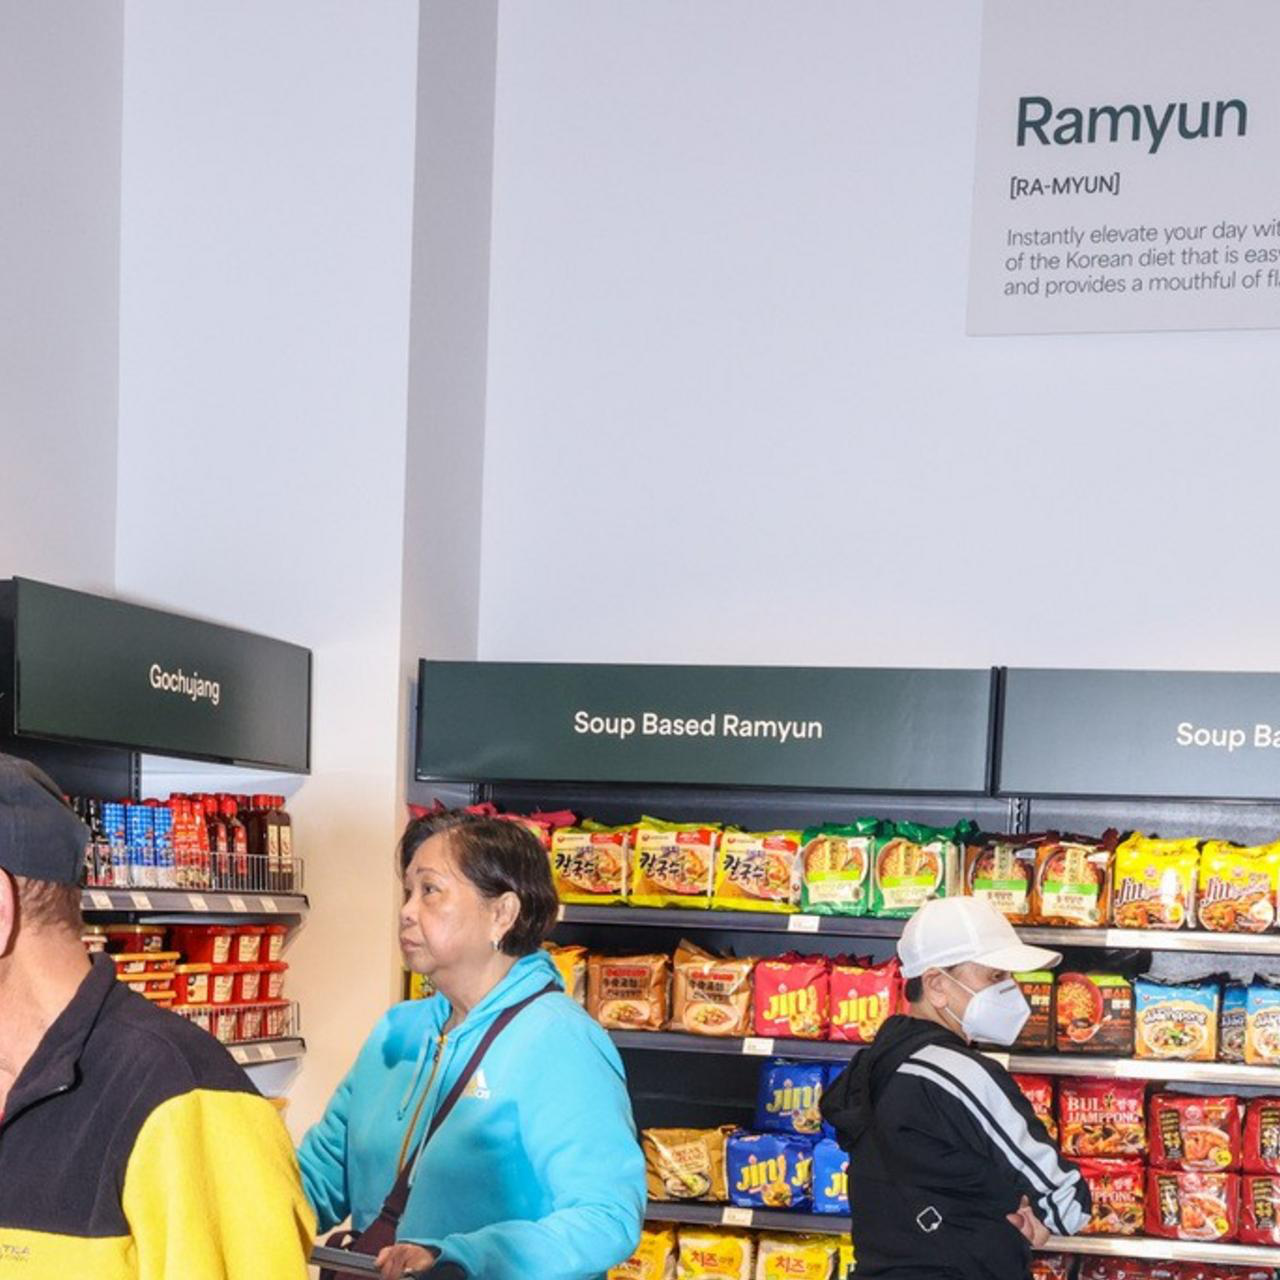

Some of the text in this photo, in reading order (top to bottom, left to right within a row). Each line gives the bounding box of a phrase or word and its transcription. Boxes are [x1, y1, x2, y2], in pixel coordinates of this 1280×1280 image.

[1017, 96, 1247, 154] Ramyun
[1010, 172, 1121, 200] [RA-MYUN]
[1007, 226, 1084, 248] Instantly
[1090, 224, 1158, 244] elevate
[1163, 225, 1207, 245] your
[1212, 221, 1247, 242] day
[1005, 252, 1024, 271] of
[1030, 252, 1060, 270] the
[1066, 250, 1133, 269] Korean
[1138, 248, 1175, 267] diet
[1181, 246, 1219, 265] that
[1225, 245, 1239, 264] is
[1004, 277, 1039, 296] and
[1045, 274, 1126, 298] provides
[1131, 278, 1144, 292] a
[1149, 271, 1236, 291] mouthful
[1242, 269, 1265, 289] of
[149, 664, 220, 706] Gochujang
[574, 710, 822, 742] Soup Based Ramyun
[1176, 721, 1247, 750] Soup
[1068, 1097, 1104, 1111] BUL
[691, 1250, 719, 1268] 치즈
[775, 1256, 806, 1274] 치즈
